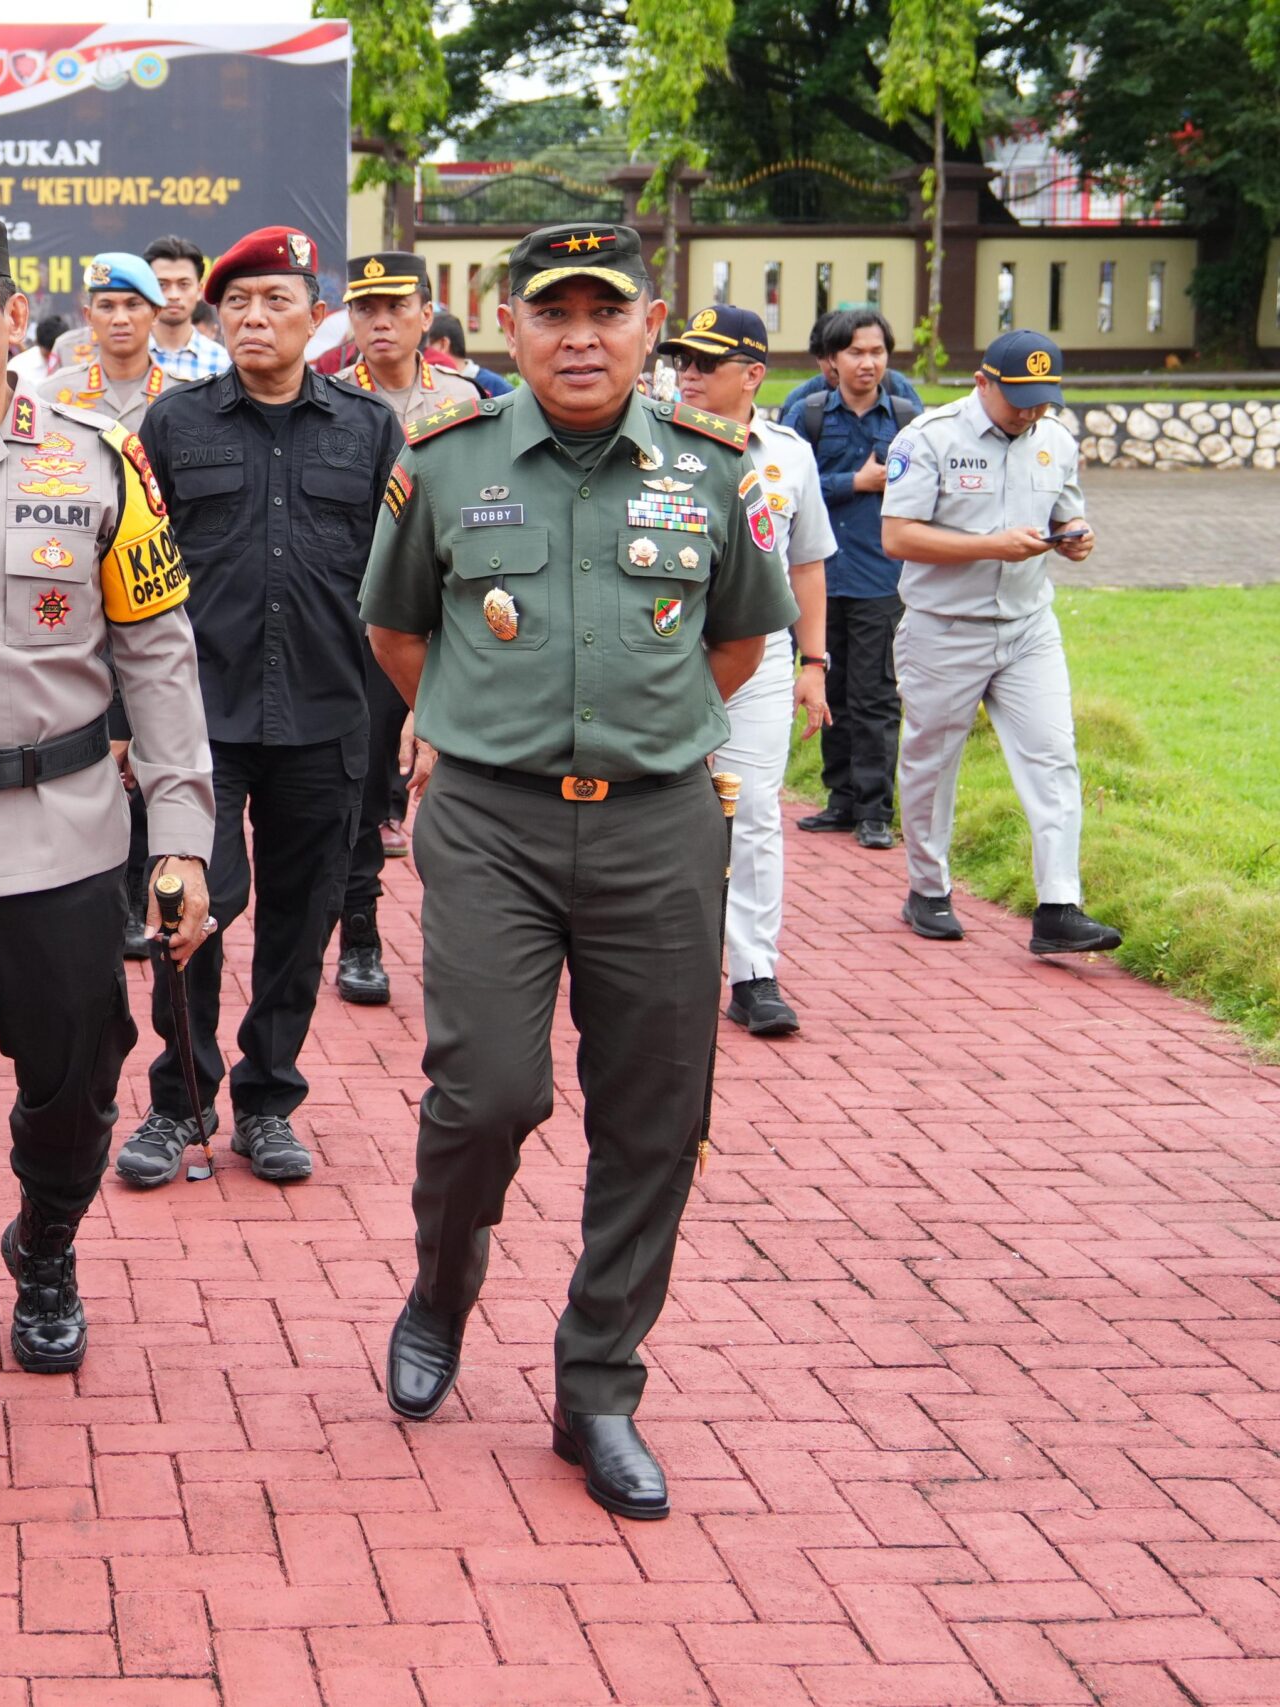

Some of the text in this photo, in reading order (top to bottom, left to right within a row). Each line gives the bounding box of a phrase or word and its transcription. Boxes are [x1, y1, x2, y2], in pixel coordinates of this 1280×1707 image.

[48, 256, 72, 293] H
[406, 421, 420, 439] TNI
[733, 424, 747, 443] TNI
[180, 447, 234, 465] DWI S
[949, 457, 988, 470] DAVID
[15, 504, 91, 527] POLRI
[472, 510, 512, 522] BOBBY
[133, 576, 164, 605] OPS
